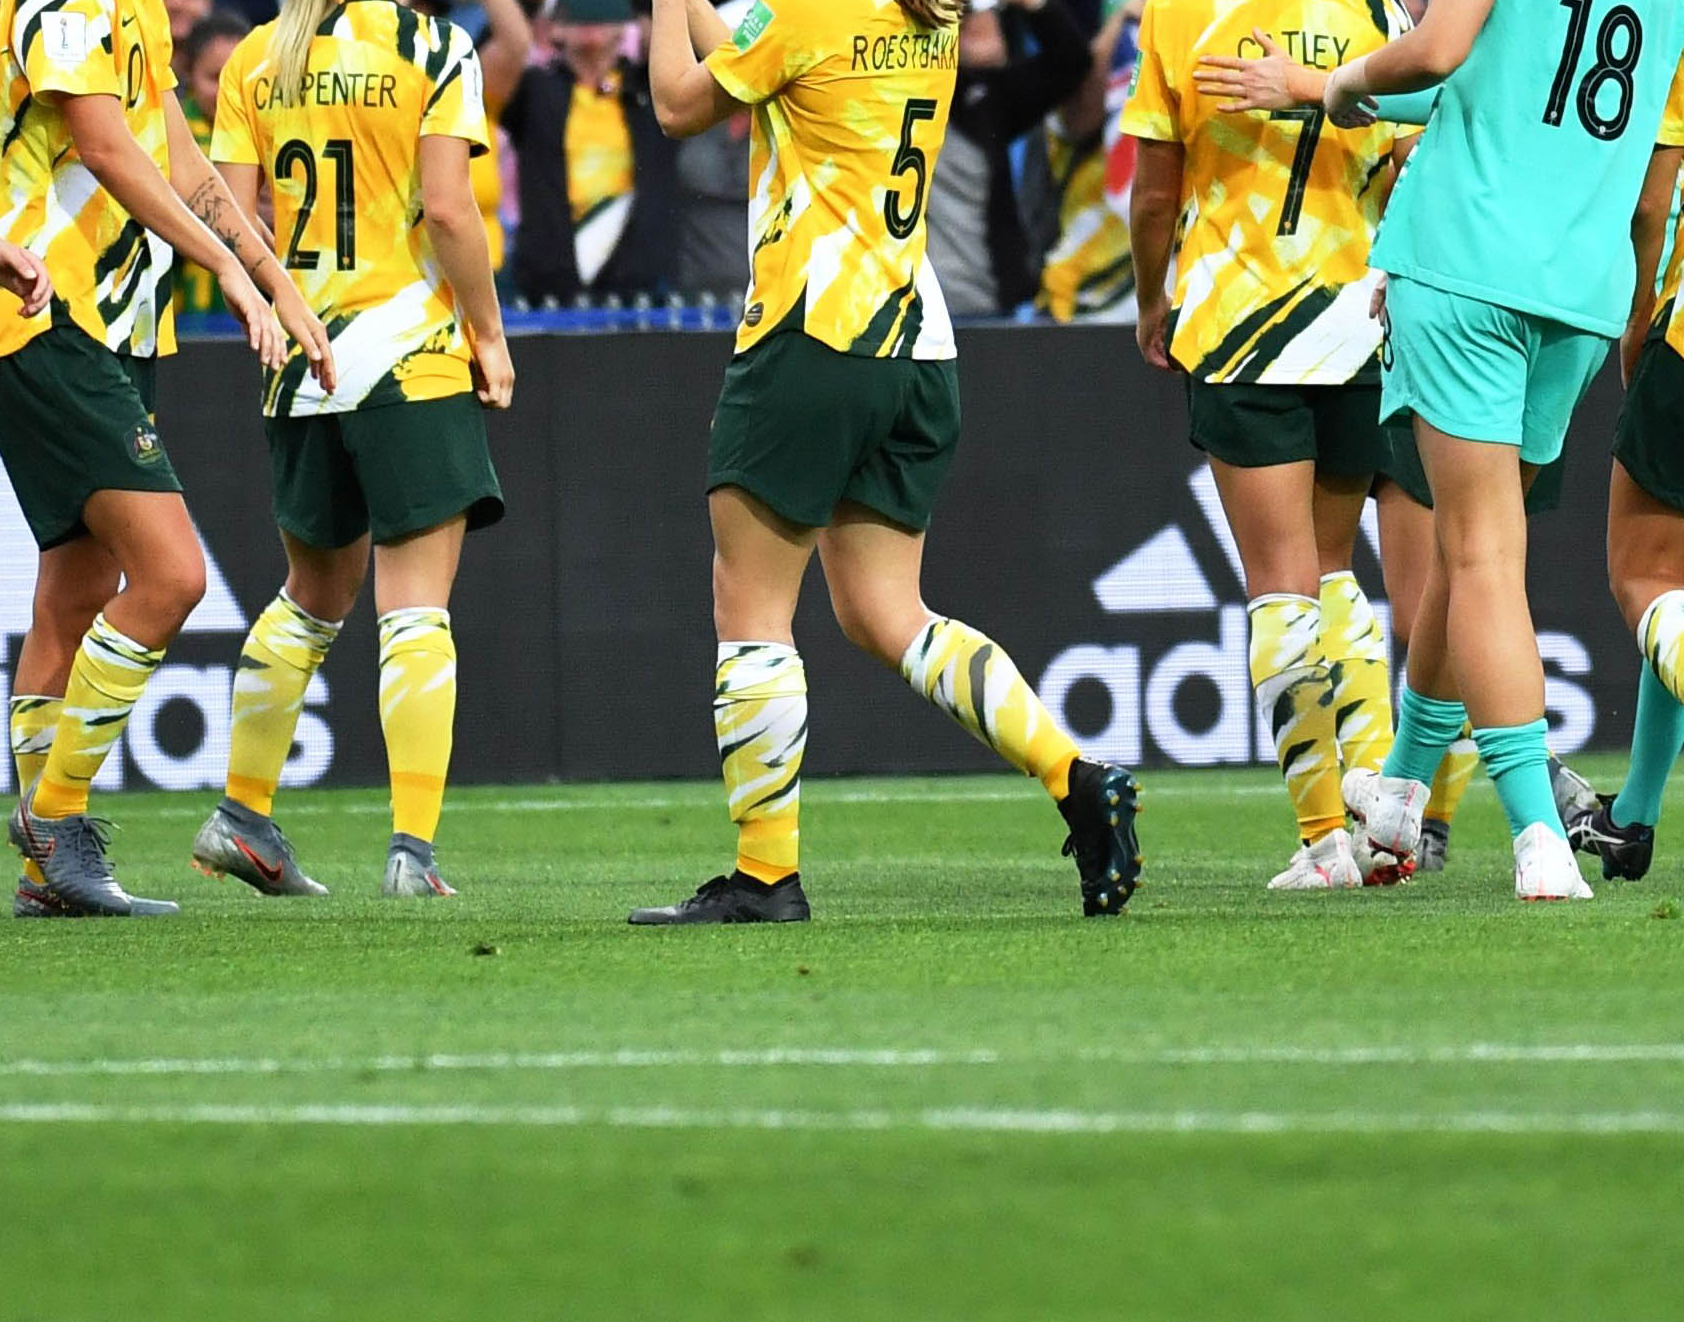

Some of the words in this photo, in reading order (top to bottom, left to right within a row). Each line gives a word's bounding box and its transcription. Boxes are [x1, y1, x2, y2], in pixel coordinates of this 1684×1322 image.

[254, 71, 398, 111] CAPENTER
[274, 138, 356, 271] 21
[883, 98, 939, 240] 5
[1268, 102, 1327, 237] 7
[1038, 604, 1596, 768] ads
